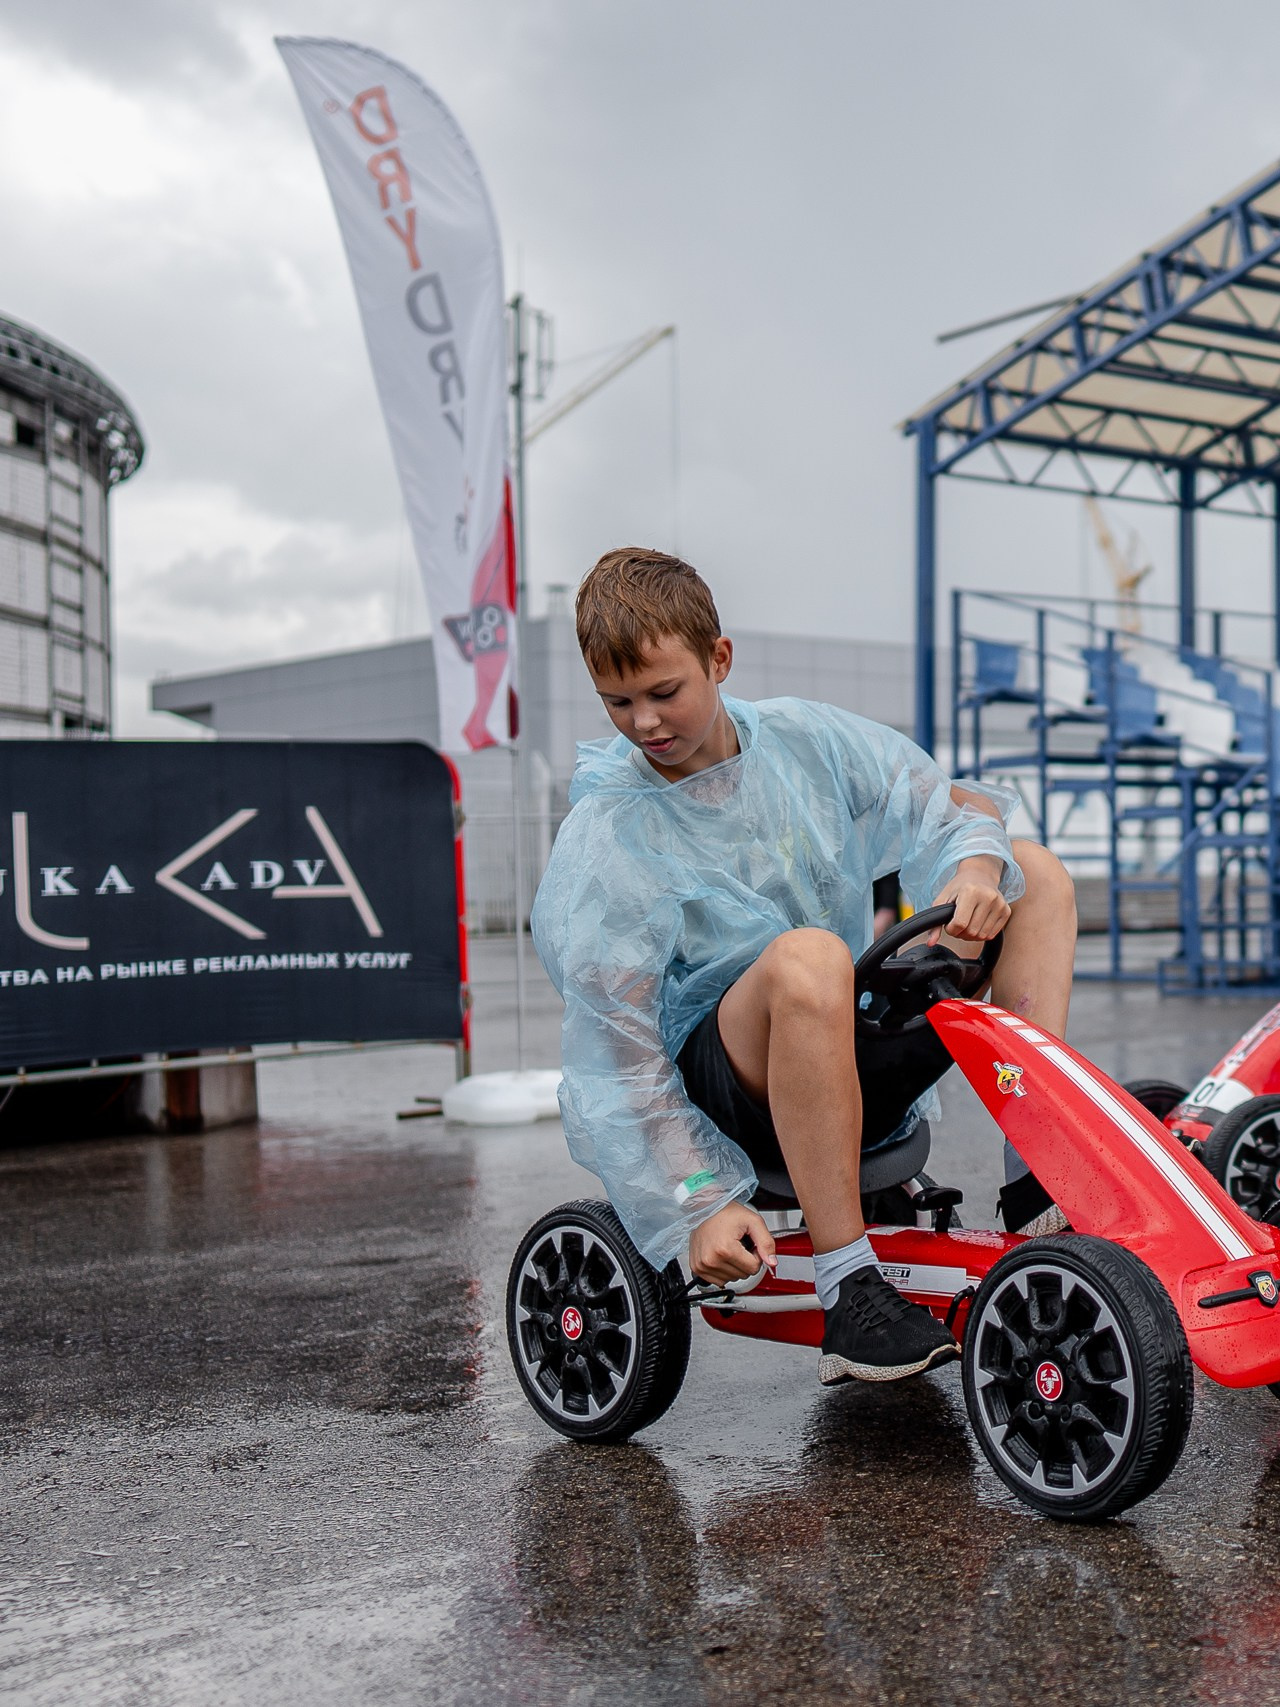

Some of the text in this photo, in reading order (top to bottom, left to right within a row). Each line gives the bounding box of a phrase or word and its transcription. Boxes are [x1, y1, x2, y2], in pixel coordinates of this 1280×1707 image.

[200, 859, 326, 891] ADV
[56, 965, 94, 983] НА
[100, 959, 188, 980] РЫНКЕ
[193, 952, 339, 973] РЕКЛАМНЫХ
[344, 952, 412, 969] УСЛУГ
